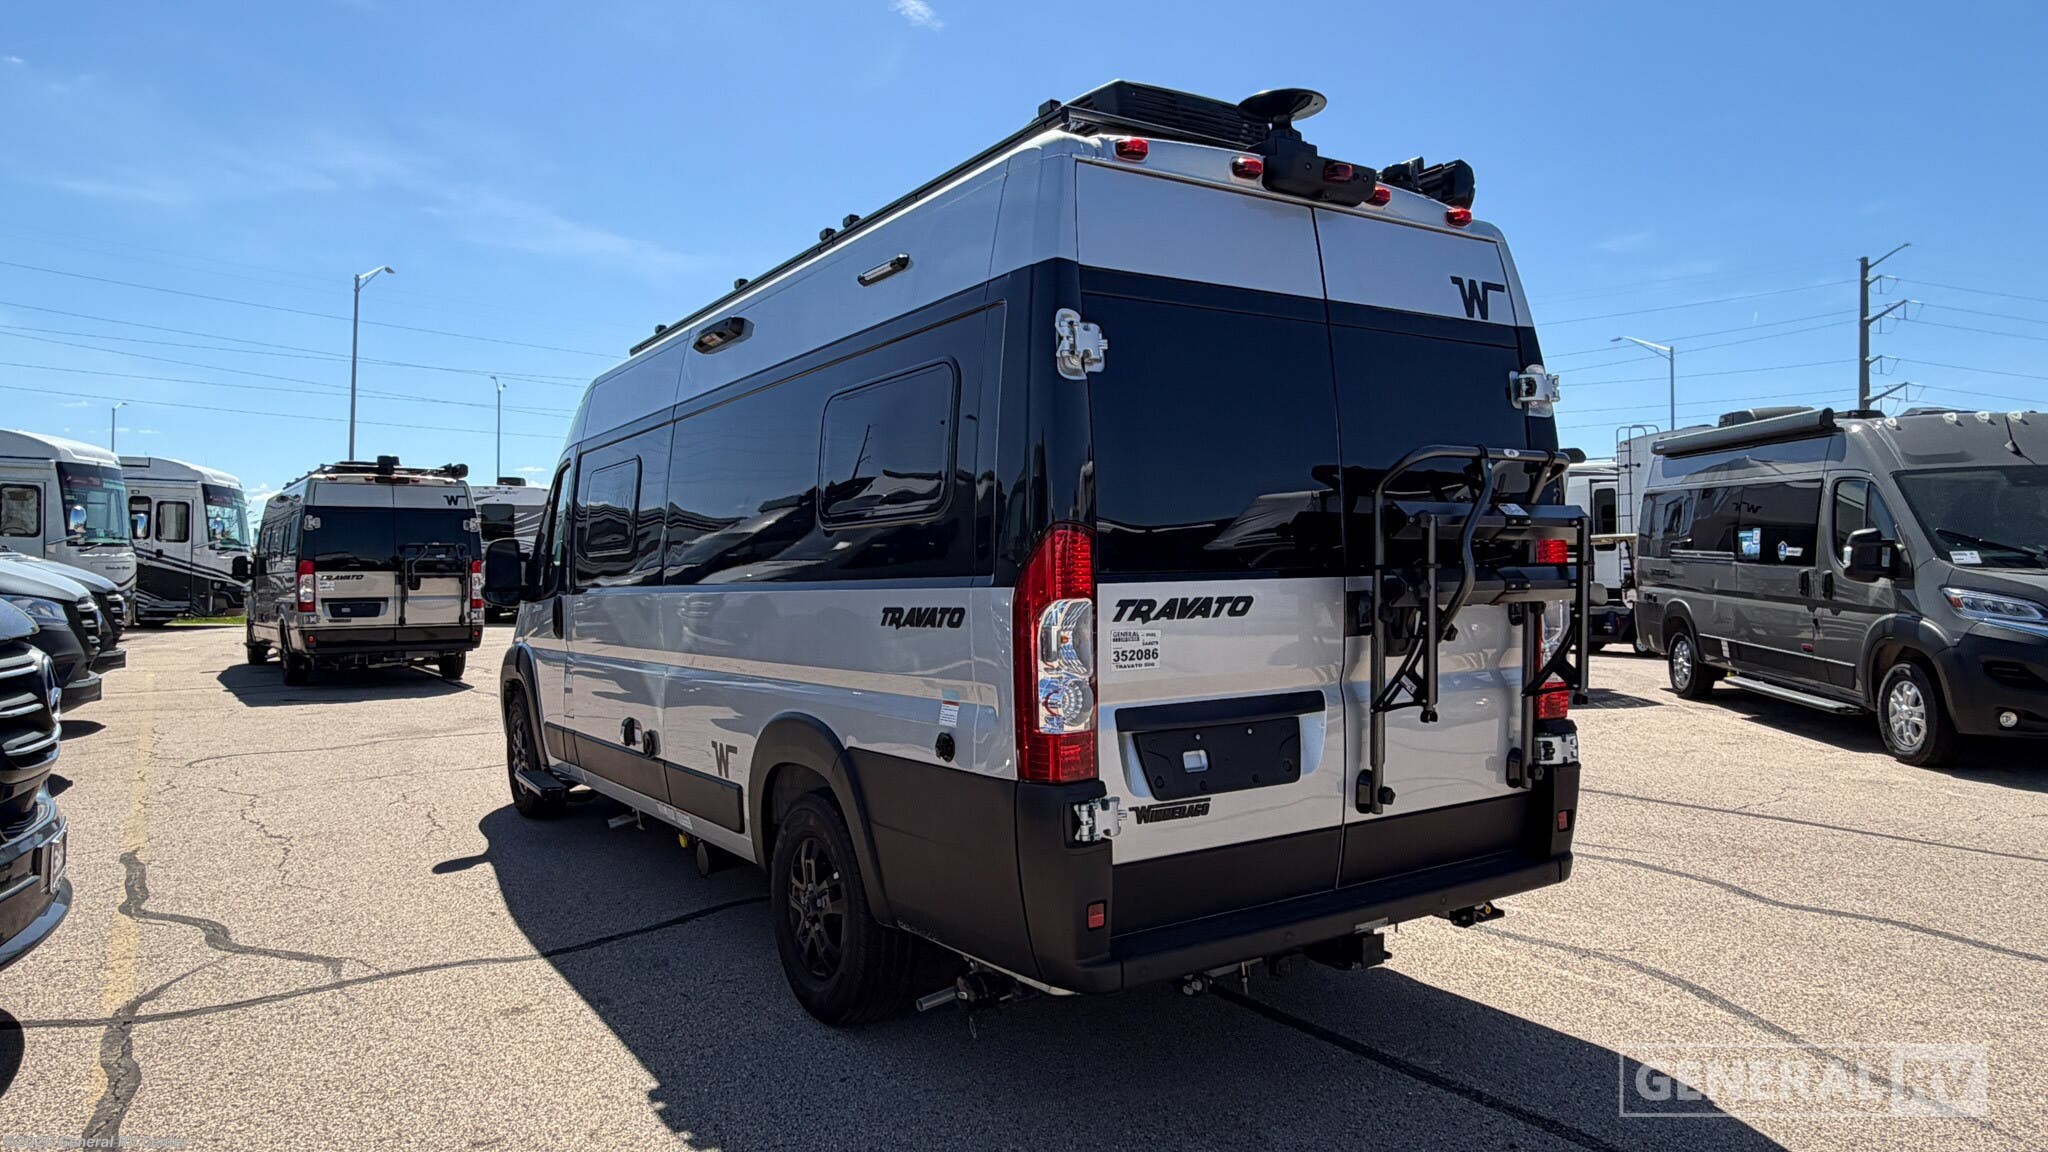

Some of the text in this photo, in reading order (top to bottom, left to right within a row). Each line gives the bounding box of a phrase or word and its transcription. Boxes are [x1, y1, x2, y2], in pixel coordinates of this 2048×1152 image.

[880, 607, 966, 630] TRAVATO
[1112, 595, 1254, 624] TRAVATO
[1112, 648, 1159, 663] 352086
